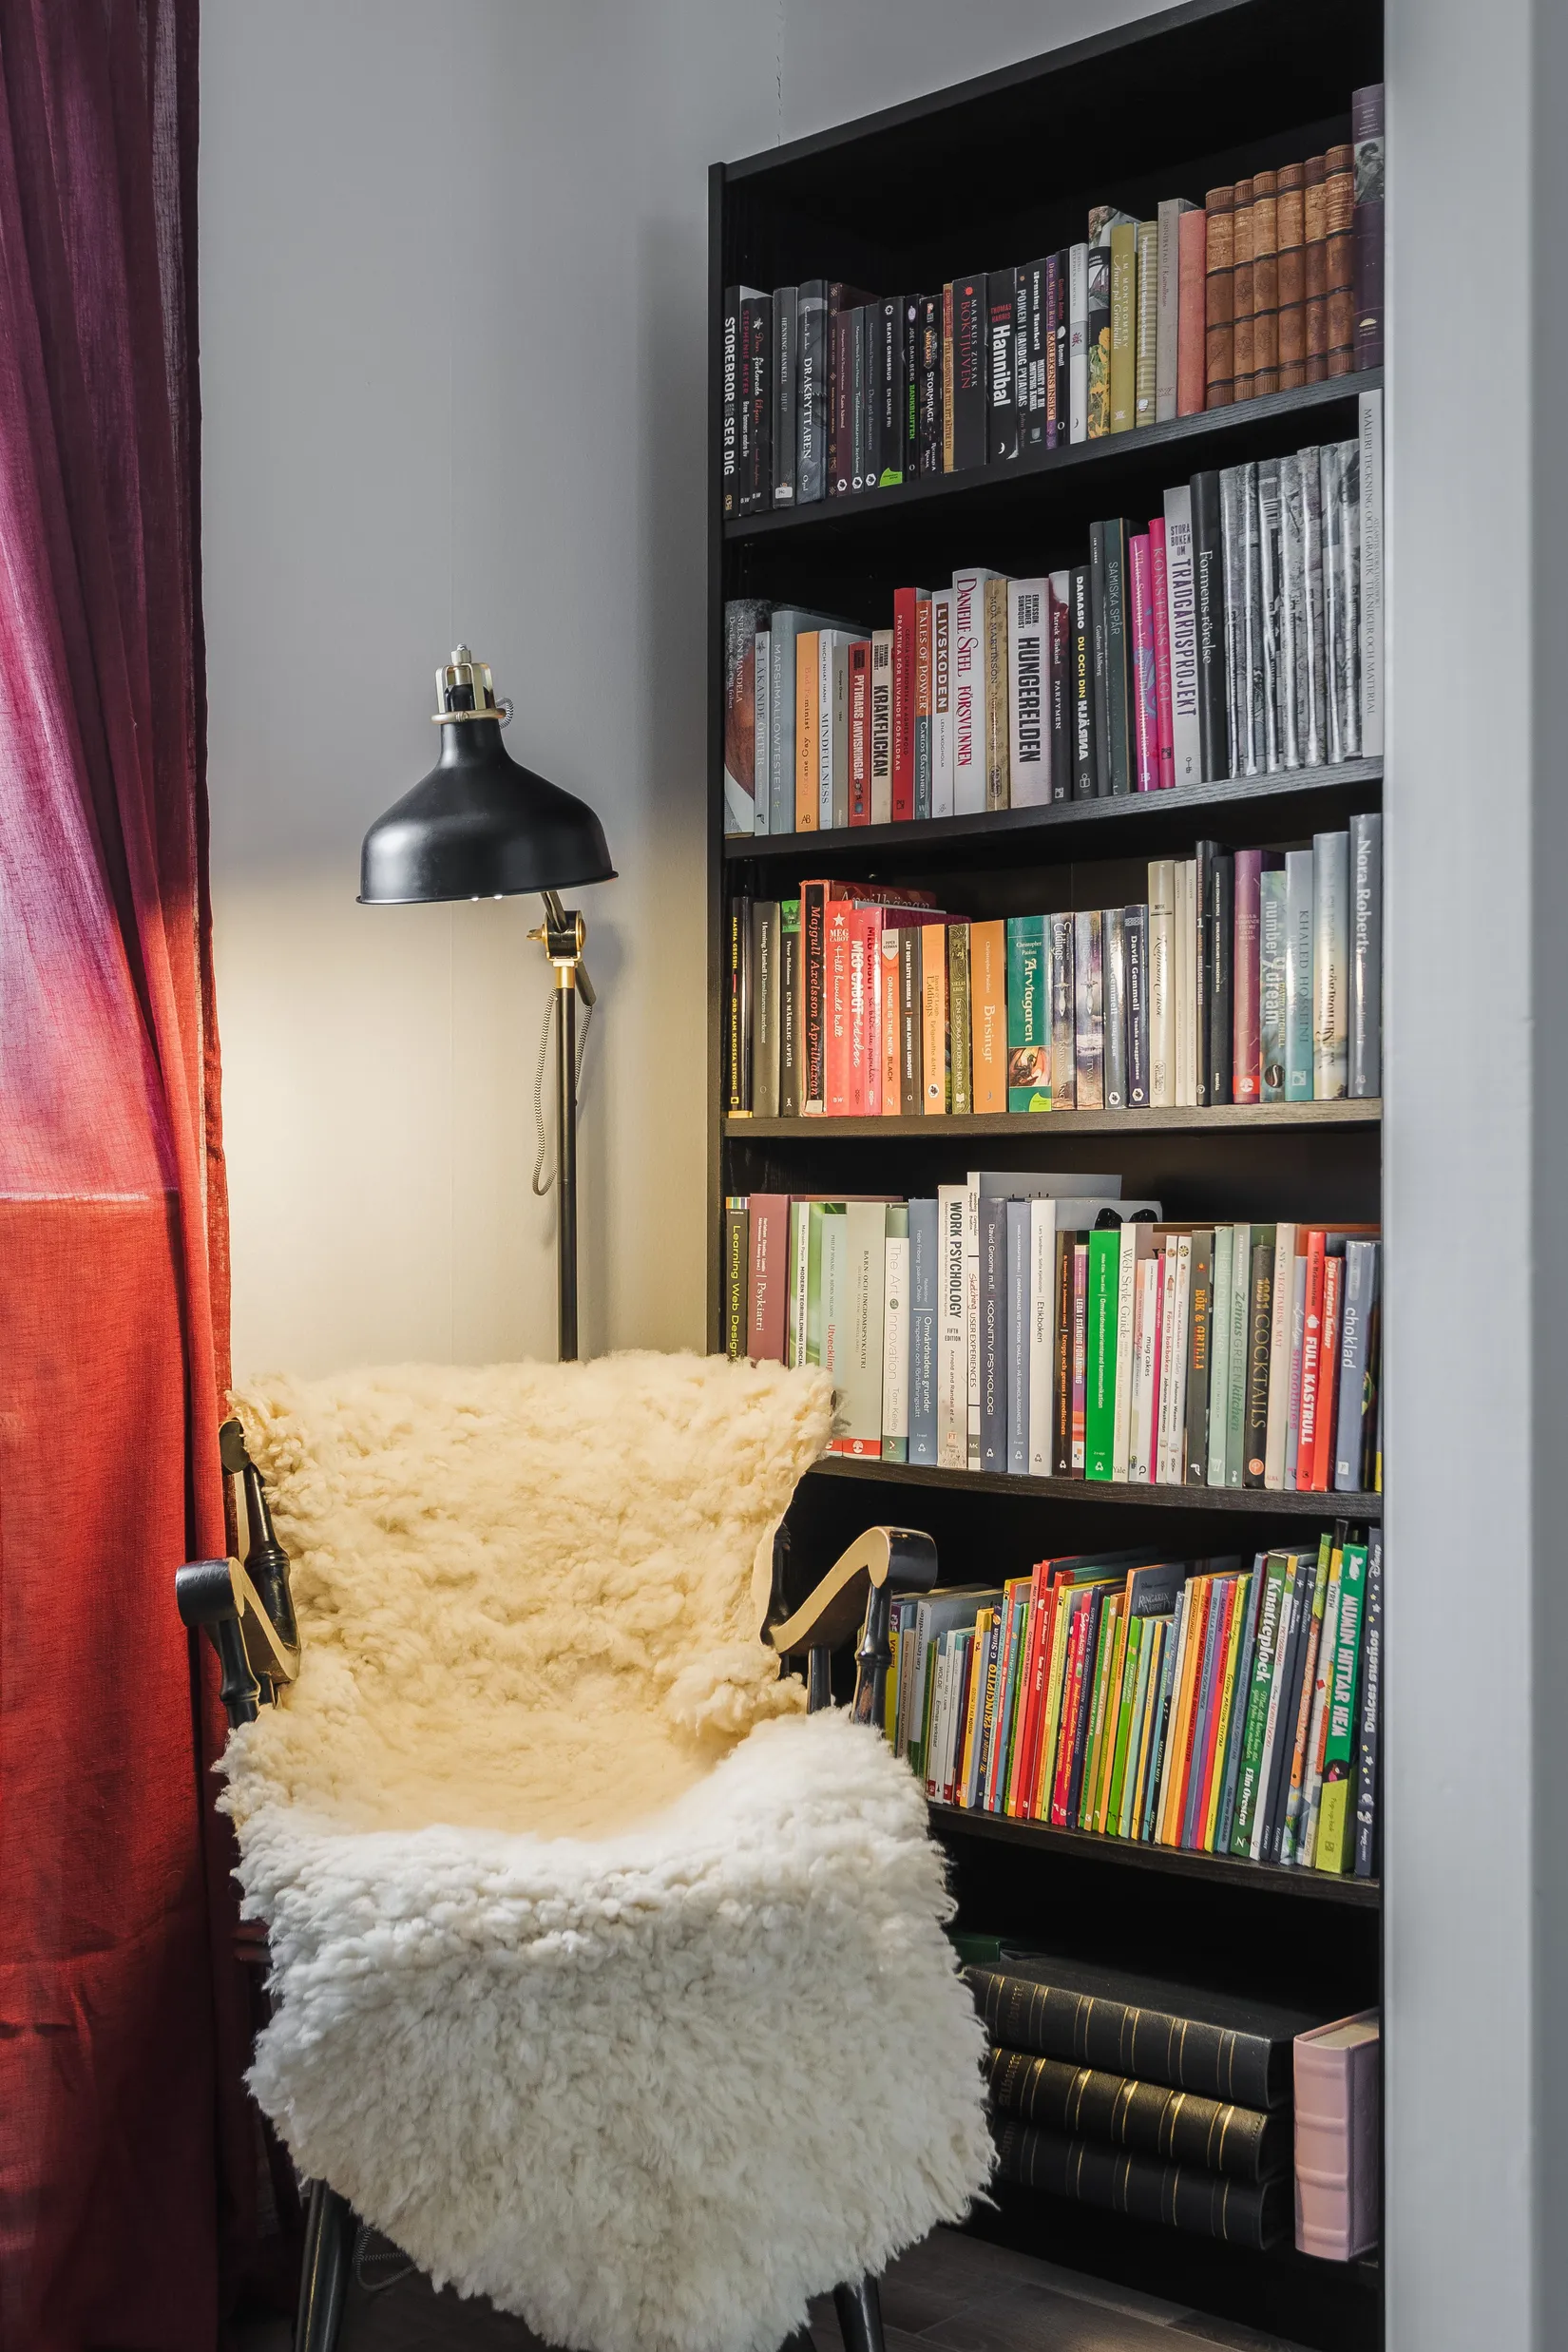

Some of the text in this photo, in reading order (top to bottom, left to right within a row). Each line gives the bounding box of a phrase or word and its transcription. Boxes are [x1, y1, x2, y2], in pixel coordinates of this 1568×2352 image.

[1017, 290, 1027, 323] POJKEN
[1113, 304, 1121, 350] Grönkulla
[724, 317, 735, 402] STOREBROR
[960, 301, 971, 389] BOKTJUVEN
[993, 325, 1011, 407] Hannibal
[1017, 332, 1027, 365] RANDIG
[1047, 333, 1057, 386] KÄRLEKENS
[802, 357, 813, 458] DRAKRYTTAREN
[926, 372, 934, 423] STORMRAGE
[1018, 367, 1027, 407] PYJAMAS
[724, 418, 734, 447] SER
[724, 451, 733, 475] DIG
[1109, 562, 1122, 635] SAMISKA SPÅR
[1154, 547, 1168, 701] KONSTENS MAGI
[1199, 550, 1214, 663] Formens rörelse
[919, 607, 928, 709] TALES OF POWER
[938, 609, 947, 708] LIVSKODEN
[957, 637, 978, 677] STEEL
[1078, 636, 1084, 651] DU
[1171, 559, 1196, 716] TRÄDGÅRDSPROJEKT
[756, 658, 768, 765] LÄKANDE ÖRTER
[773, 644, 781, 792] MARSHMALLOWTESTET
[853, 675, 865, 718] PYTHIANS
[956, 686, 973, 767] FÖRSVUNNEN
[1018, 638, 1040, 763] HUNGERELDEN
[852, 720, 864, 779] ANVISNINGAR
[873, 685, 889, 776] KRÅKFLICKAN
[1357, 840, 1371, 883] Nora
[1265, 901, 1284, 955] number
[1356, 889, 1371, 953] Roberts
[787, 992, 791, 1003] EN
[809, 906, 820, 1096] Majgull Axelsson Aprilhäxan
[833, 946, 843, 1037] Håll huvudet kallt
[1022, 958, 1037, 1042] Arvtagaren
[1131, 967, 1139, 1010] Gemmell
[1265, 972, 1283, 1024] dream
[1299, 910, 1309, 1042] KHALED HOSSEINI
[982, 1005, 995, 1063] Brisingr
[732, 1225, 740, 1279] Learning
[889, 1274, 901, 1293] Art
[890, 1244, 901, 1269] The
[948, 1202, 962, 1318] WORK PSYCHOLOGY
[755, 1282, 766, 1330] Psykiatri
[968, 1273, 978, 1310] Sketching
[1120, 1249, 1133, 1338] Web Style Guide
[1195, 1290, 1207, 1310] RÖK
[1214, 1251, 1231, 1354] Hello cupcake!
[730, 1315, 739, 1357] Design
[889, 1312, 899, 1379] Innovation
[922, 1316, 931, 1412] Omvårdnadens grunder
[1194, 1326, 1205, 1369] GRILLA
[1231, 1291, 1245, 1431] Zeinas GREEN kitchen
[1343, 1308, 1358, 1367] choklad
[1251, 1314, 1269, 1428] COCKTAILS
[1290, 1349, 1301, 1429] smoothies
[1302, 1336, 1317, 1444] FULL KASTRULL
[1256, 1578, 1282, 1682] Knatteplock
[1331, 1594, 1358, 1736] MUMIN HITTAR HEM
[1239, 1768, 1253, 1826] Elin Oresten
